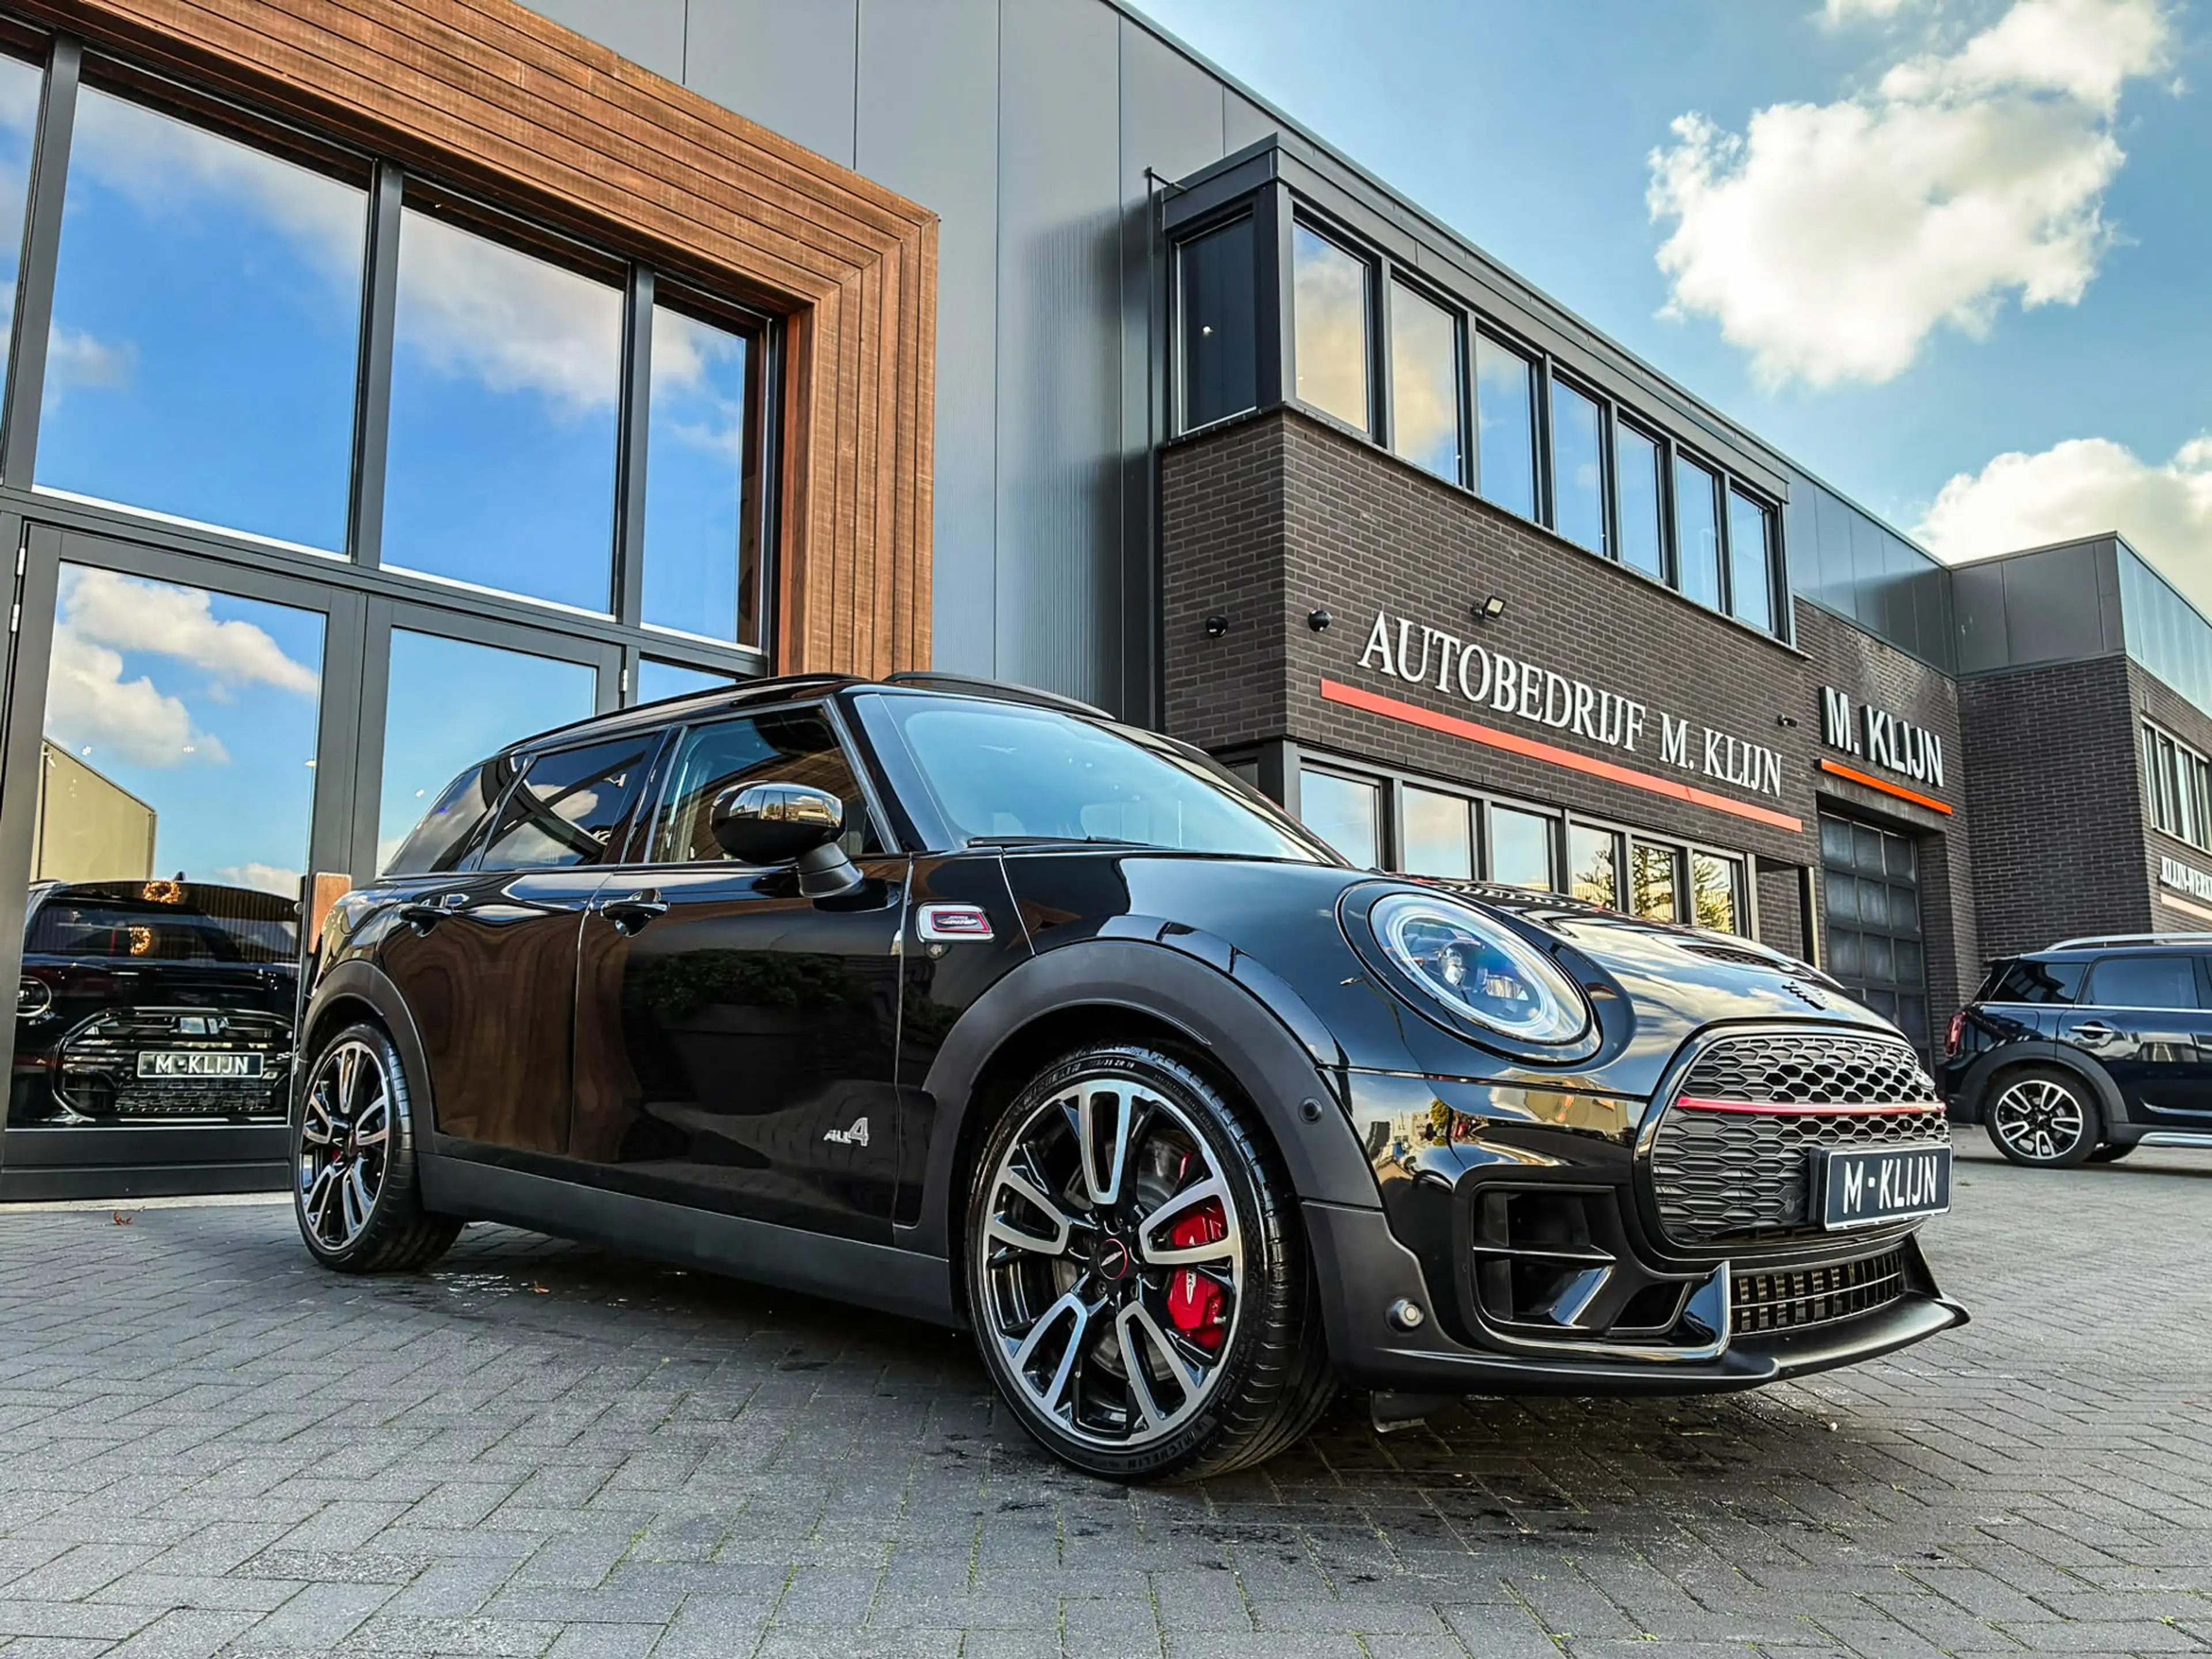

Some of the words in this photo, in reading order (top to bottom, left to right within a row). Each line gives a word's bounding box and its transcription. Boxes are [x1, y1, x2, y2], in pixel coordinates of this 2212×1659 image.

[1357, 611, 1646, 751] AUTOBEDRIJF
[1659, 713, 1694, 770] M.
[1703, 727, 1783, 797] KLIJN
[1821, 685, 1859, 754] M.
[1863, 704, 1944, 787] KLIJN
